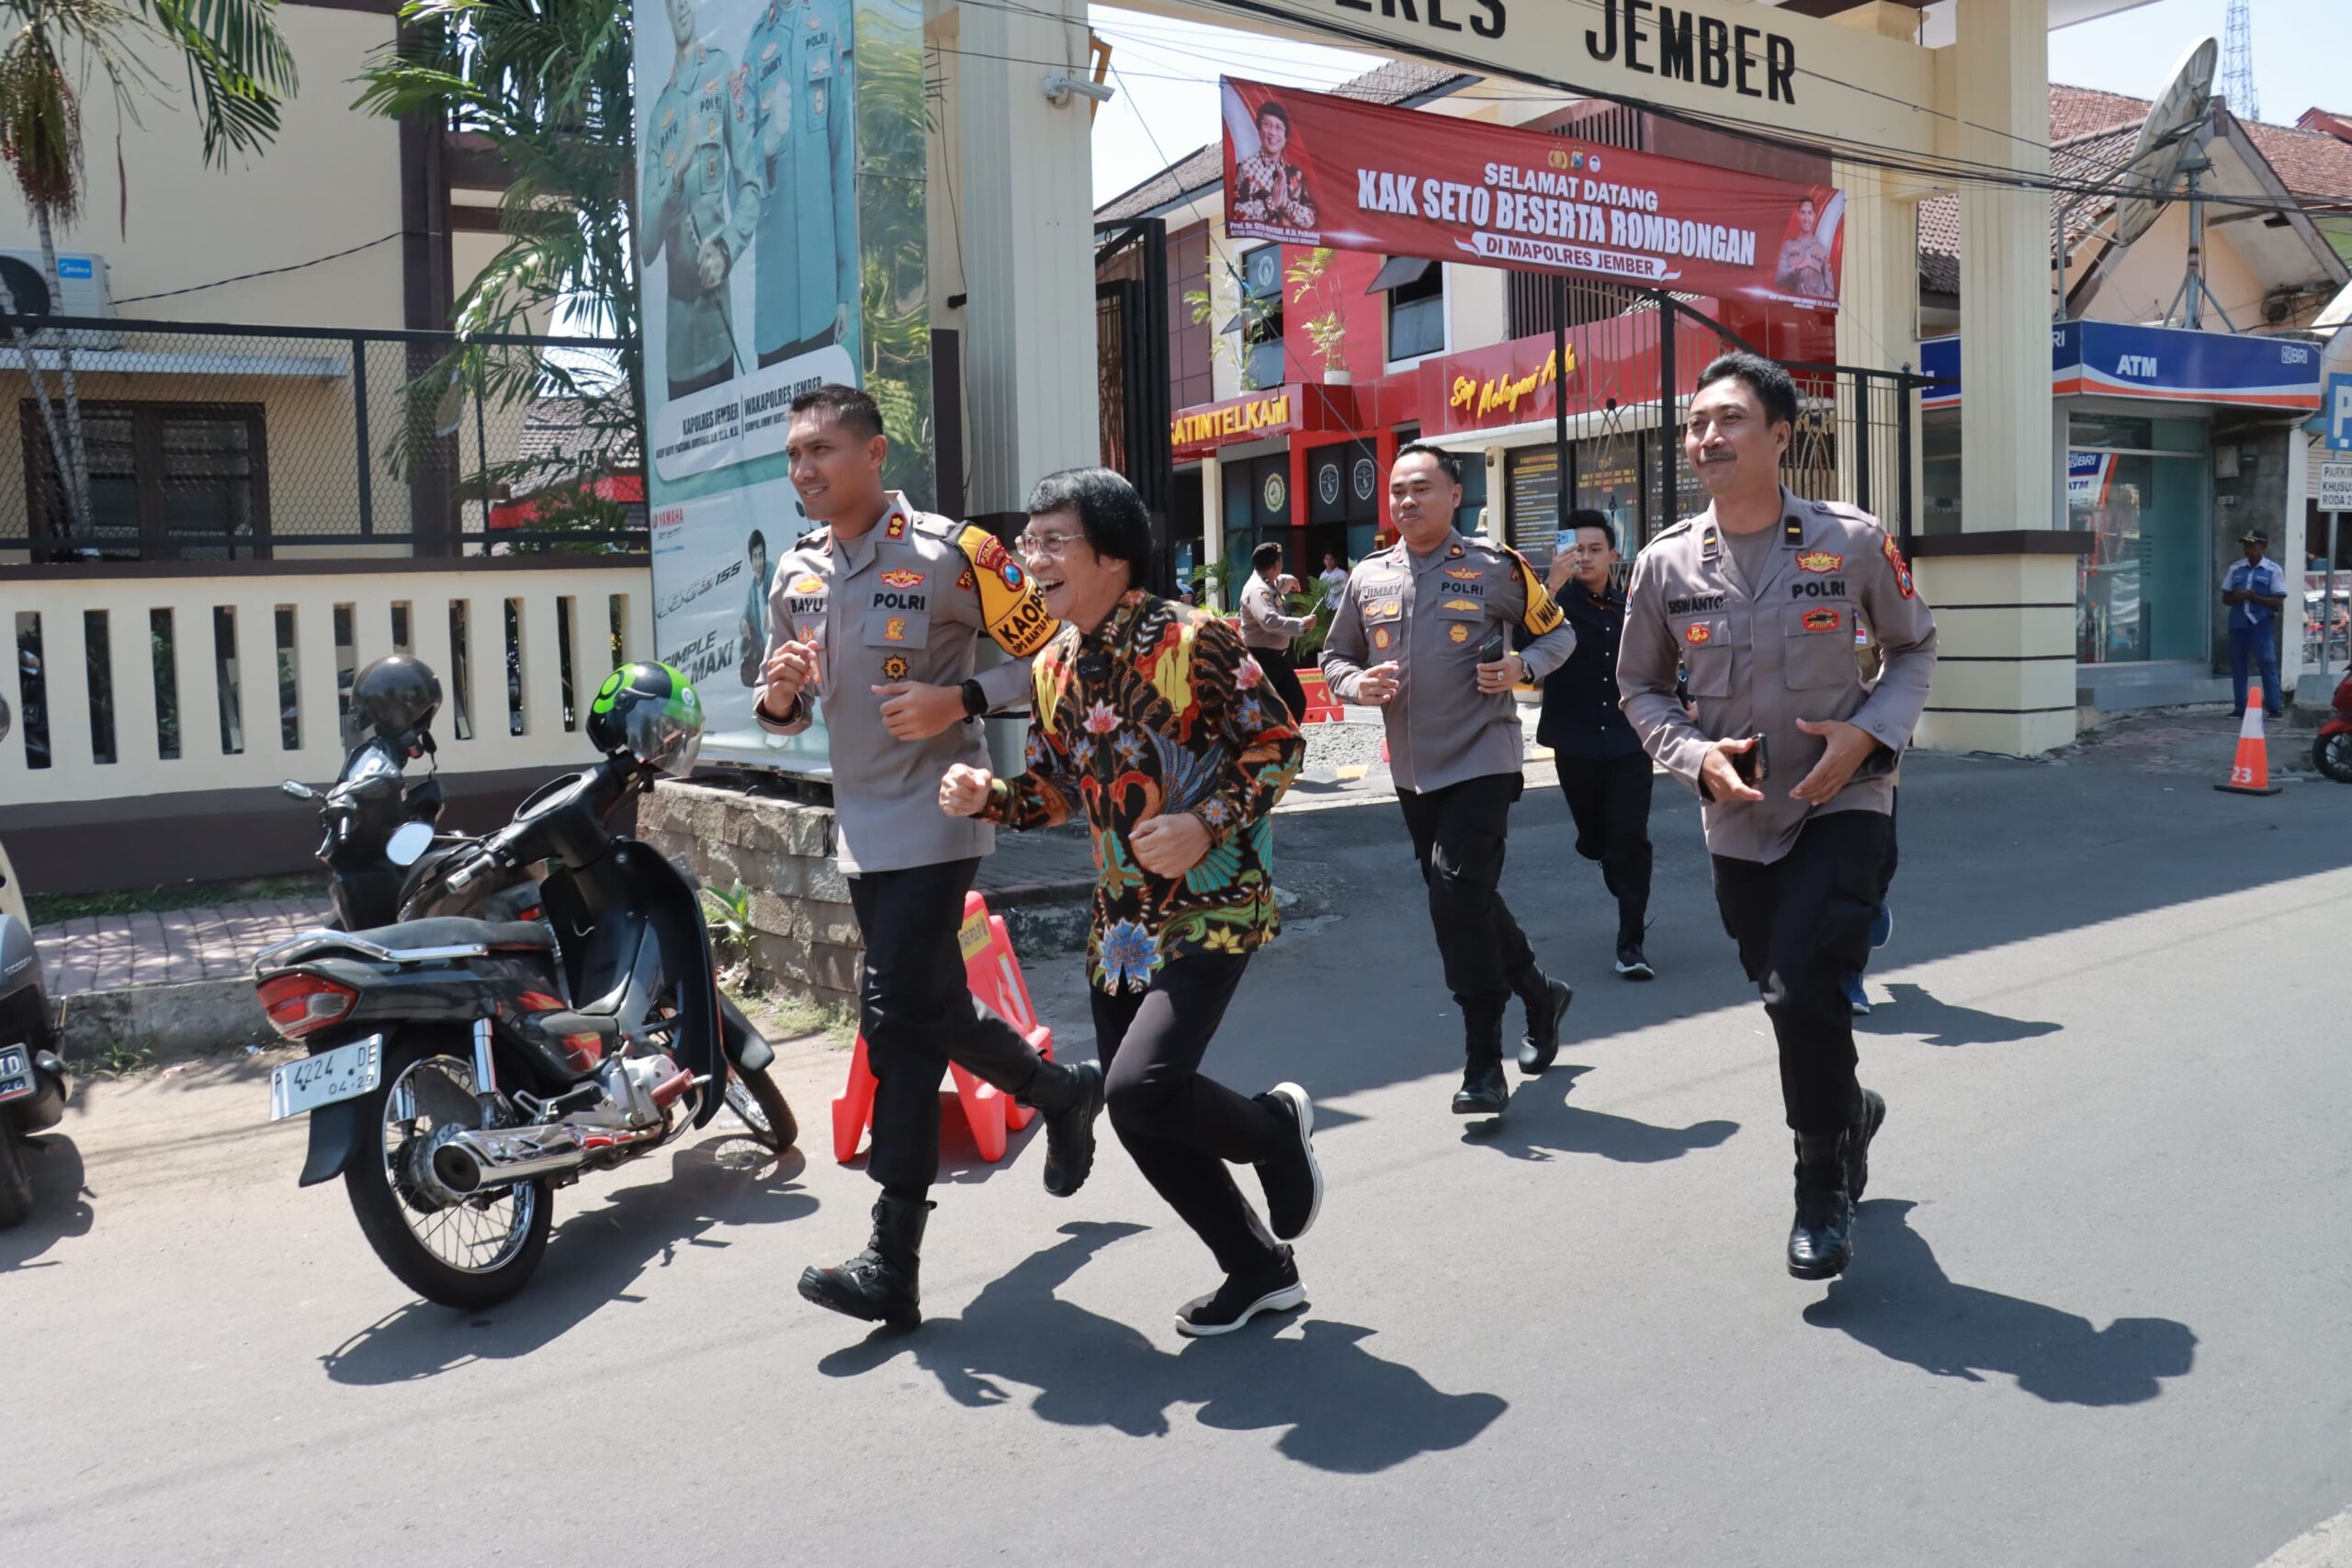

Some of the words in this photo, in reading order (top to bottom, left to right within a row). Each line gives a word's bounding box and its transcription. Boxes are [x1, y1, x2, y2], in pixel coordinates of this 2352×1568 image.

[1586, 0, 1796, 105] JEMBER
[1485, 163, 1579, 199] SELAMAT
[1583, 186, 1658, 212] DATANG
[1357, 169, 1419, 217] KAK
[1422, 178, 1490, 228] SETO
[1495, 190, 1603, 247] BESERTA
[1610, 209, 1757, 266] ROMBONGAN
[1486, 237, 1501, 254] DI
[1507, 241, 1594, 267] MAPOLRES
[1596, 254, 1655, 276] JEMBER
[2052, 331, 2065, 348] RI
[2291, 347, 2308, 365] BRI
[2117, 355, 2157, 378] ATM
[744, 385, 792, 416] WAKAPOLRES
[715, 402, 740, 426] JEMBER
[2323, 481, 2352, 493] KHUSU
[2323, 494, 2345, 506] RODA
[658, 508, 684, 529] YAMAHA
[715, 559, 743, 586] 155
[1363, 584, 1402, 599] JIMMY
[1441, 581, 1484, 596] POLRI
[1792, 581, 1846, 599] POLRI
[791, 597, 824, 615] BAYU
[873, 592, 926, 611] POLRI
[2231, 765, 2253, 784] 23
[293, 1053, 334, 1087] 4224
[356, 1044, 377, 1067] DE
